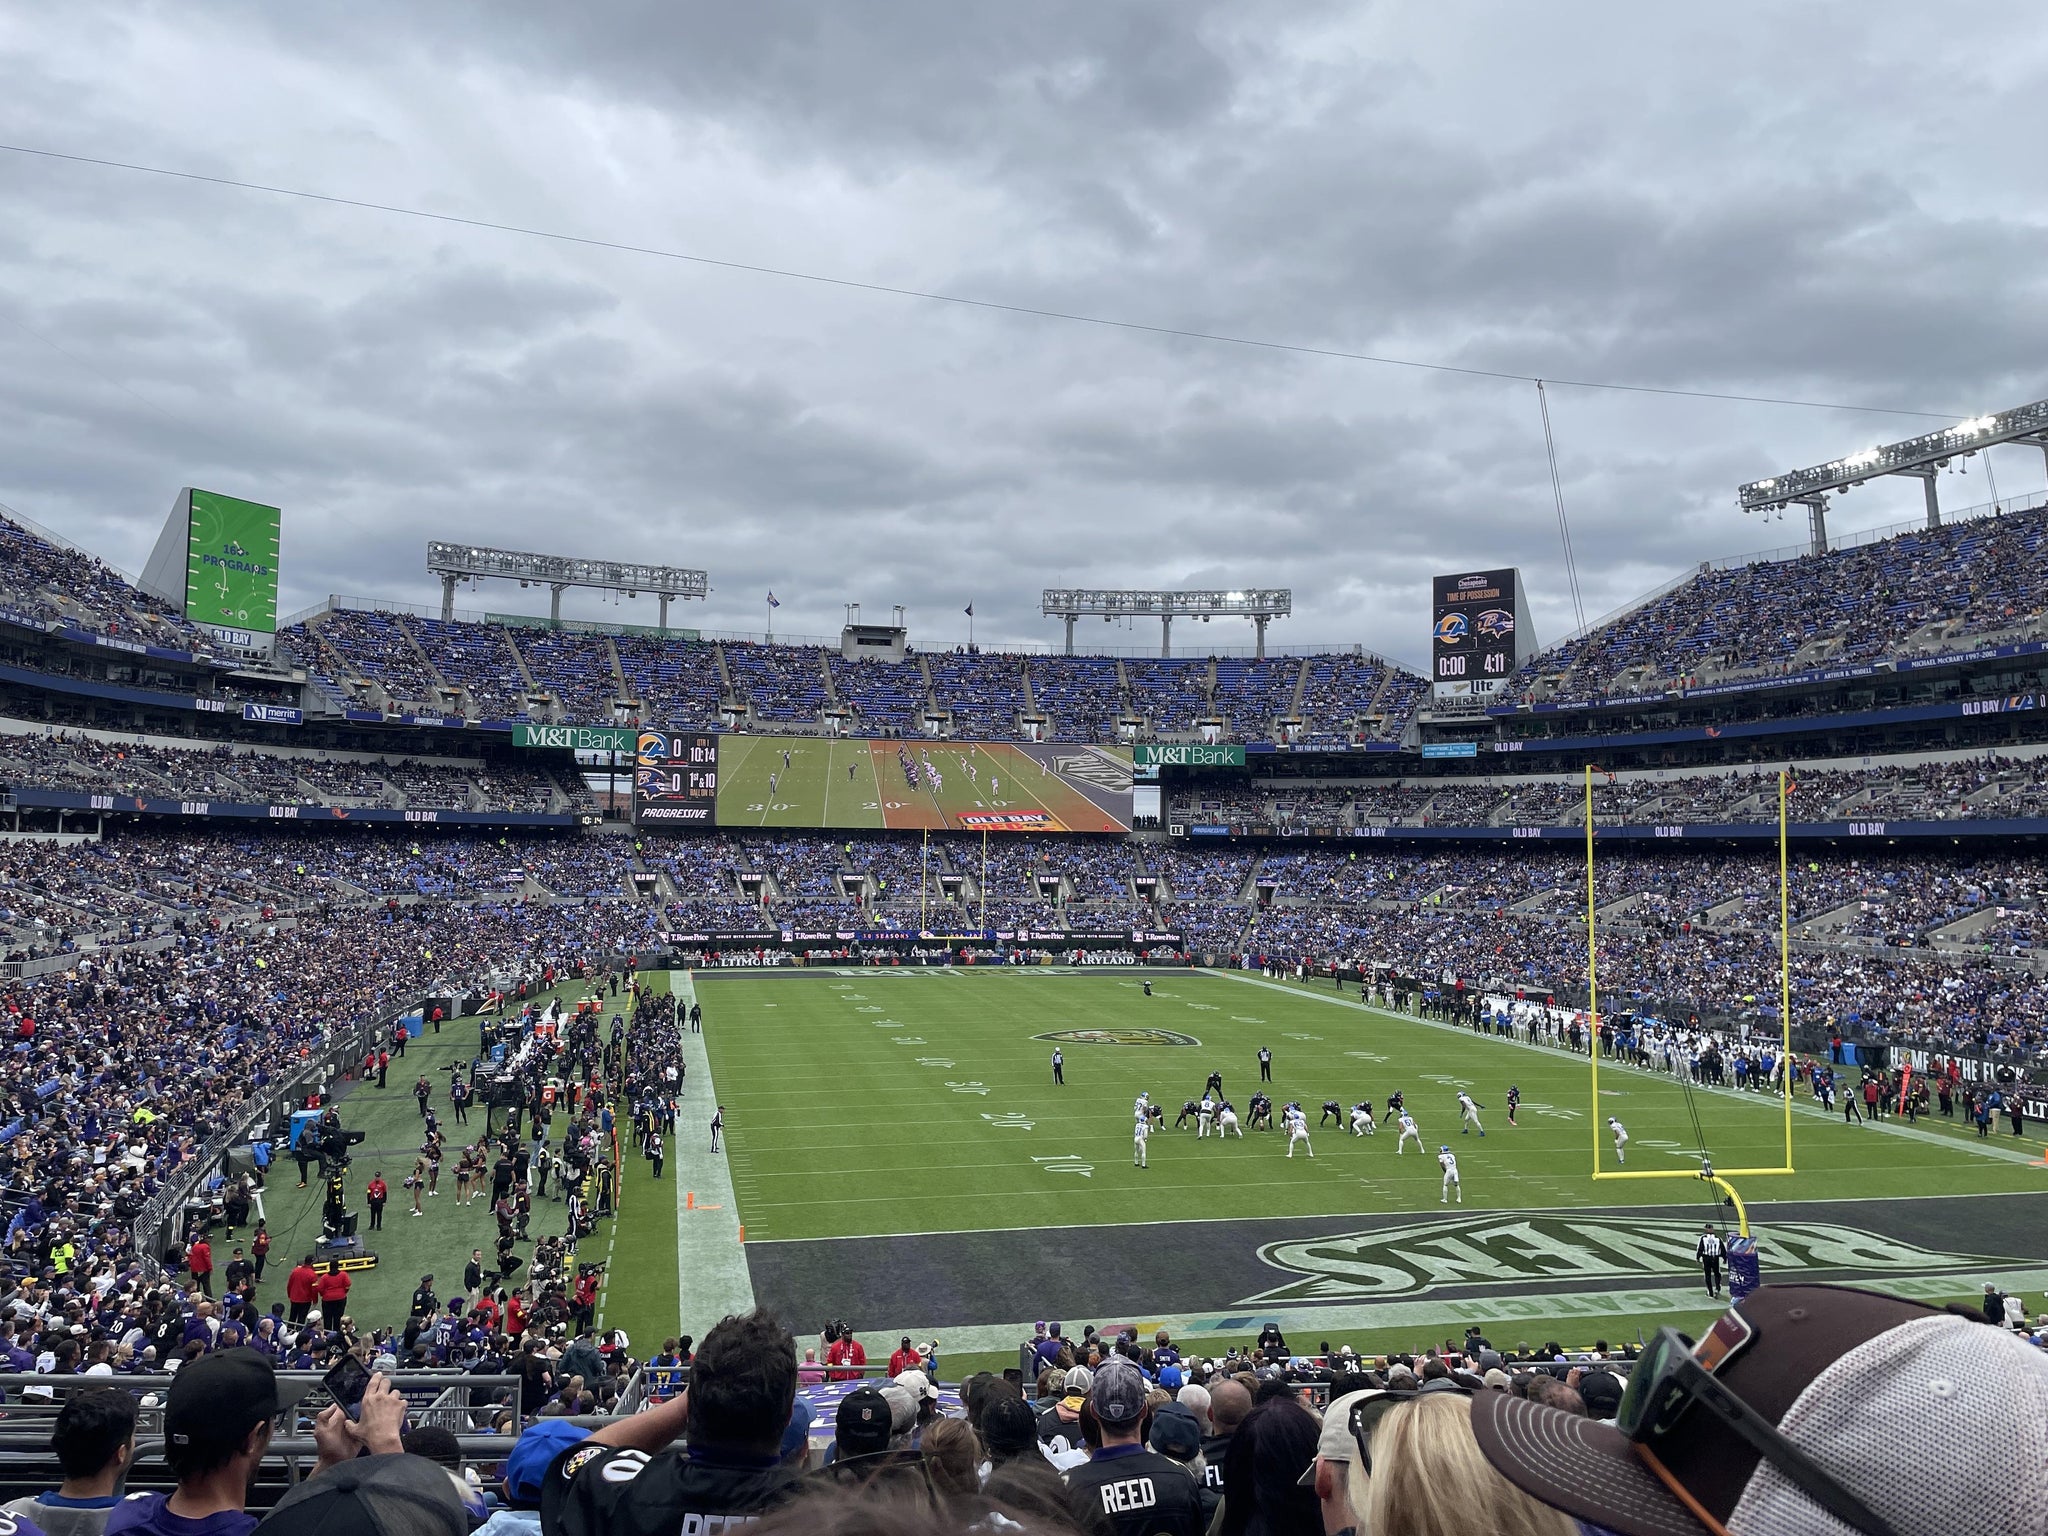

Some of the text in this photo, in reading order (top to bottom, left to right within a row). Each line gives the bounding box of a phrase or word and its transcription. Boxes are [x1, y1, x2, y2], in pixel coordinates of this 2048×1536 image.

[1447, 588, 1500, 602] TIME OF POSSESSION
[214, 629, 250, 645] OLD BAY
[1440, 653, 1504, 676] 0:00 4:11
[1912, 658, 1936, 668] MICHAEL
[1824, 670, 1844, 680] ARTHUR
[1851, 668, 1872, 676] MODELL
[196, 698, 226, 712] OLD BAY
[1962, 700, 2000, 716] OLD BAY
[268, 708, 296, 719] merritt
[526, 726, 625, 750] M&T Bank
[673, 738, 682, 757] 0
[1494, 742, 1523, 752] OLD BAY
[690, 747, 715, 762] 10:14
[1146, 746, 1235, 764] M&T Bank
[672, 773, 680, 792] 0
[705, 773, 715, 788] 10
[91, 795, 114, 809] OLD BAY
[182, 802, 209, 815] OLD BAY
[270, 806, 298, 818] OLD BAY
[405, 811, 438, 822] OLD BAY
[642, 808, 708, 818] PROGRESSIVE
[966, 814, 1045, 824] OLD BAY
[582, 816, 602, 825] 10:14
[1192, 827, 1228, 835] PROGRESSIVE
[1355, 827, 1386, 837] OLD BAY
[1512, 828, 1541, 838] OLD BAY
[1655, 826, 1683, 837] OLD BAY
[1849, 822, 1885, 836] OLD BAY
[1954, 1057, 1978, 1082] THE
[1983, 1061, 2024, 1081] FLK
[543, 1091, 551, 1099] G
[980, 1112, 1036, 1127] 20
[1030, 1154, 1095, 1172] 10
[1450, 1156, 1454, 1165] 3
[1450, 1293, 1676, 1319] CATCH
[157, 1323, 168, 1338] 8
[1343, 1359, 1360, 1374] 26
[656, 1371, 671, 1388] 17
[1100, 1478, 1156, 1515] REED
